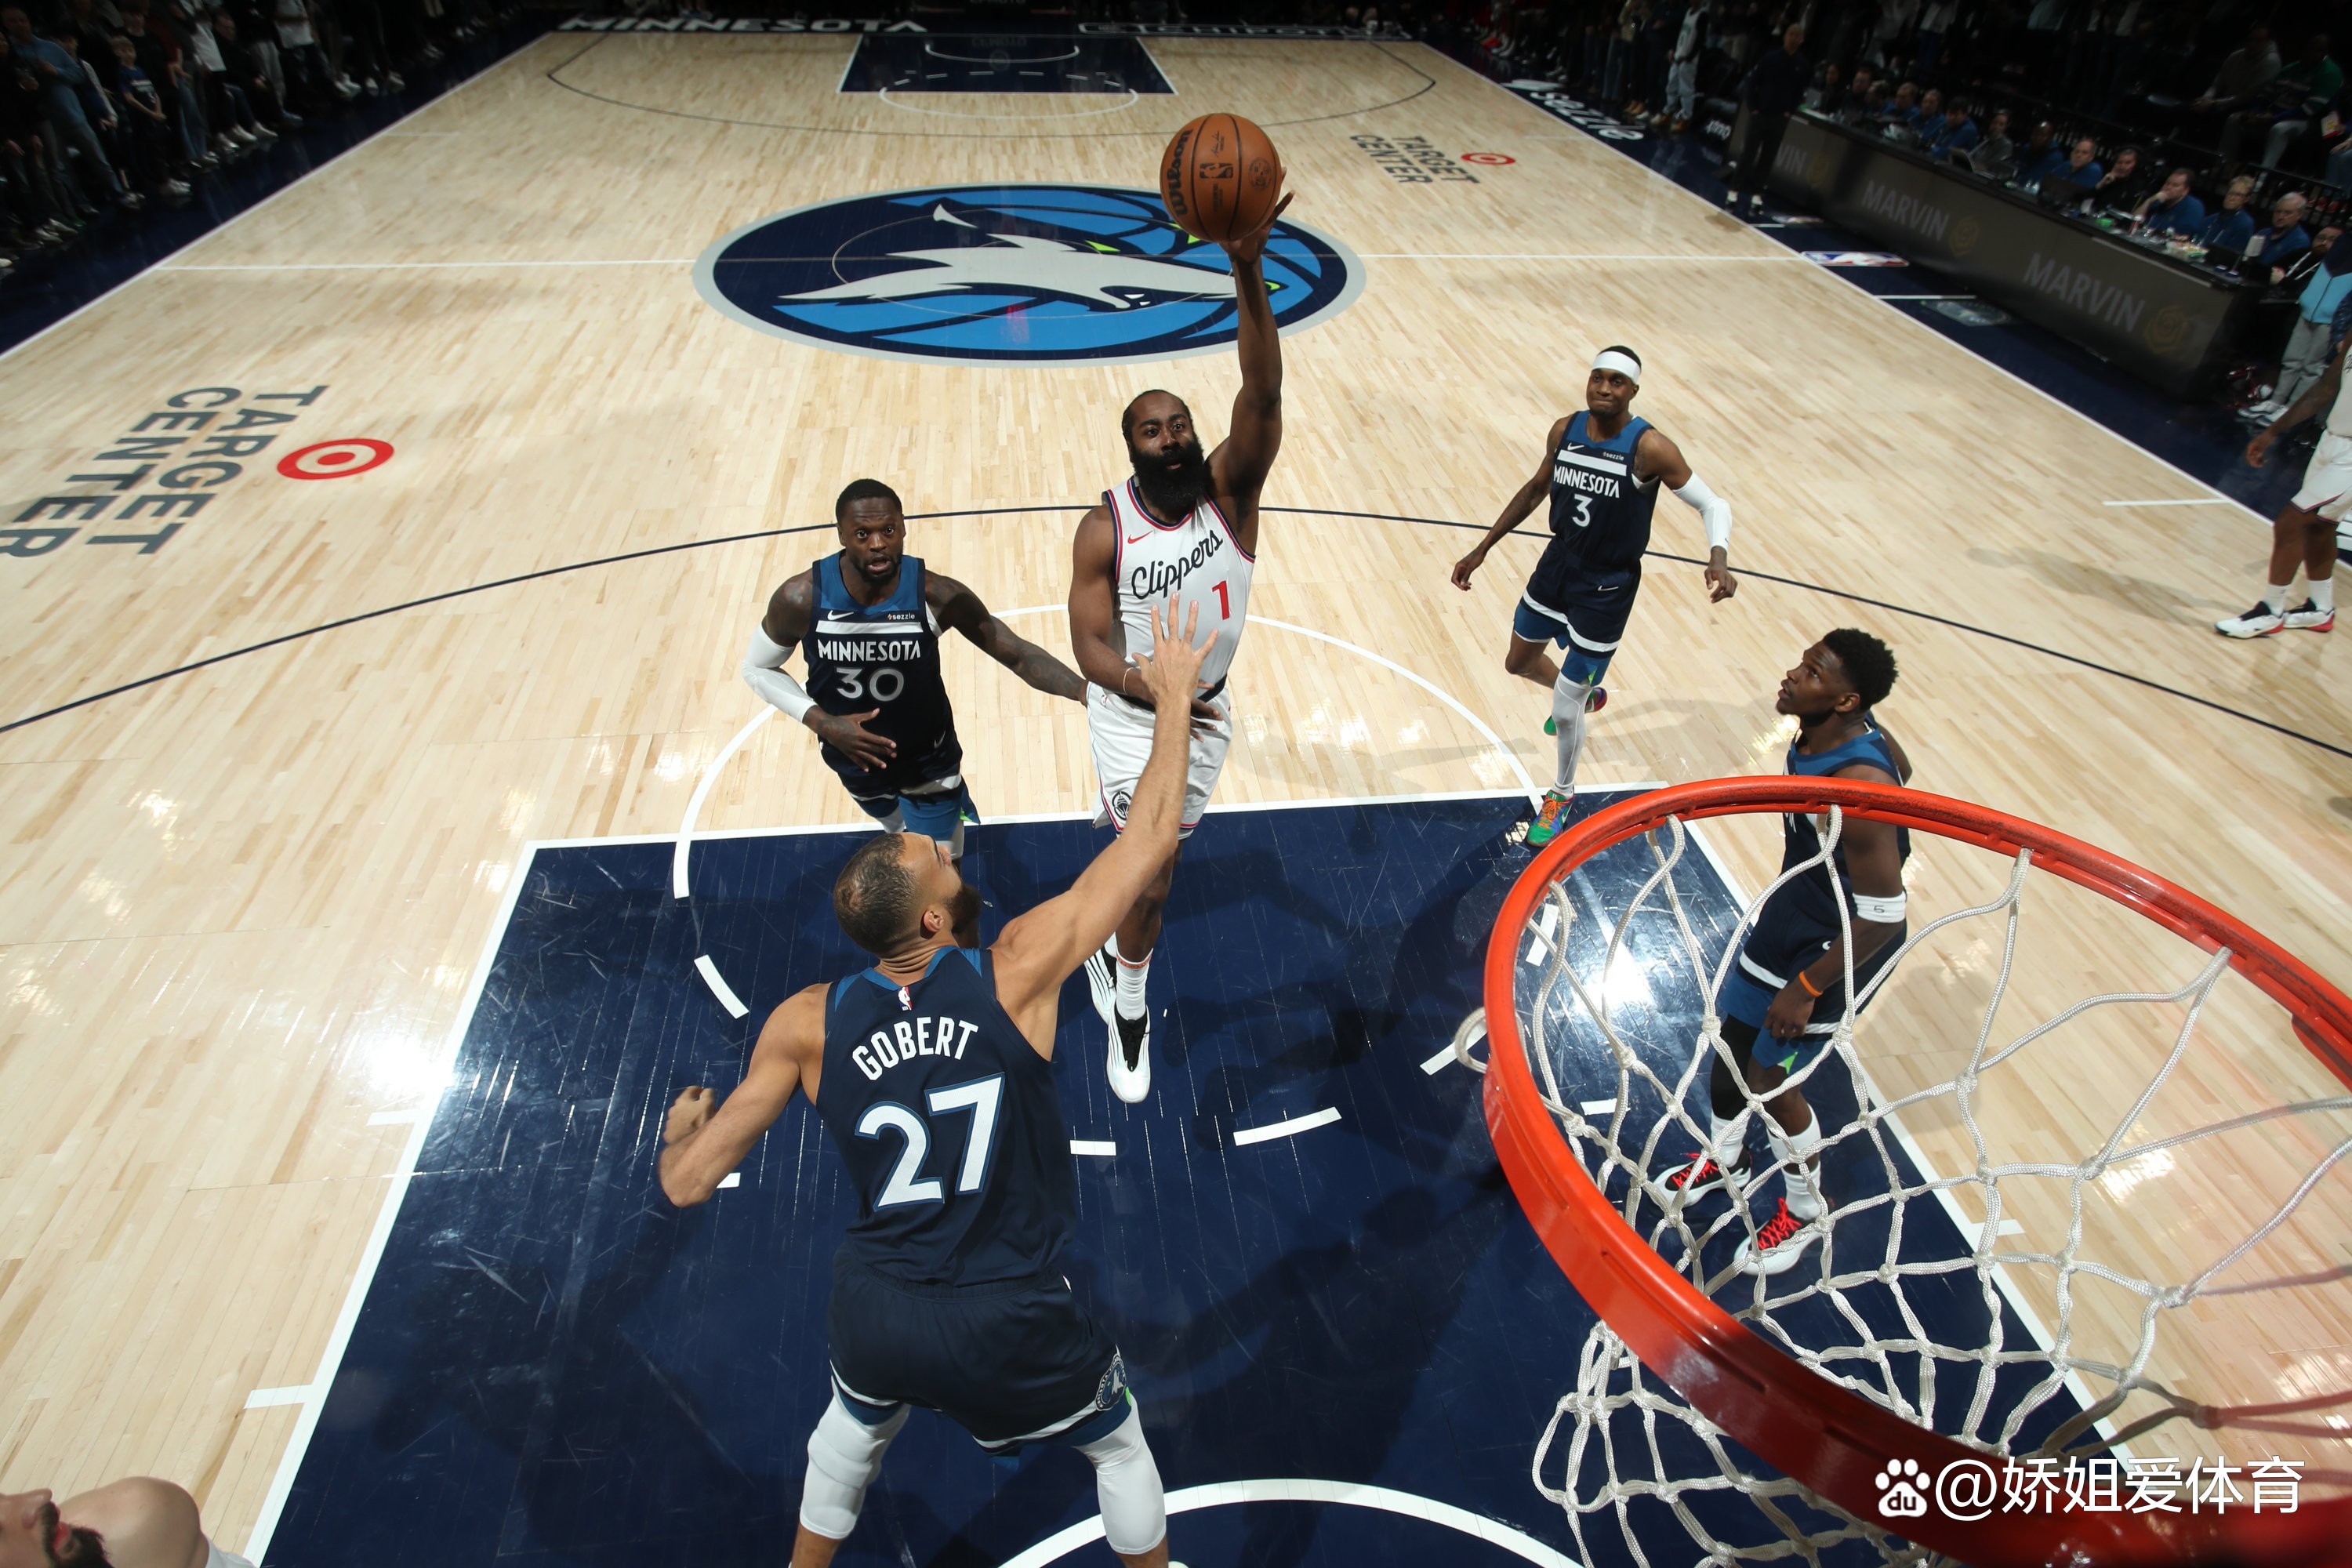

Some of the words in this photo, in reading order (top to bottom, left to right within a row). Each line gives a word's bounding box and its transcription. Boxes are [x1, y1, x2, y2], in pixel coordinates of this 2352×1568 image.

[557, 17, 928, 32] MINNESOTA
[1530, 92, 1646, 140] sezzle
[1167, 129, 1192, 217] Wilson
[1350, 134, 1433, 184] CENTER
[1392, 136, 1480, 184] TARGET
[1860, 180, 1950, 241] MARVIN
[2023, 252, 2145, 333] MARVIN
[0, 387, 241, 558] CENTER
[87, 386, 328, 555] TARGET
[1553, 464, 1620, 499] MINNESOTA
[1572, 493, 1593, 528] 3
[1131, 529, 1223, 600] Clippers
[1211, 580, 1230, 620] 1
[818, 639, 921, 662] MINNESOTA
[835, 666, 905, 702] 30
[1875, 905, 1885, 913] 5
[852, 1016, 978, 1081] GOBERT
[855, 1072, 1006, 1213] 27
